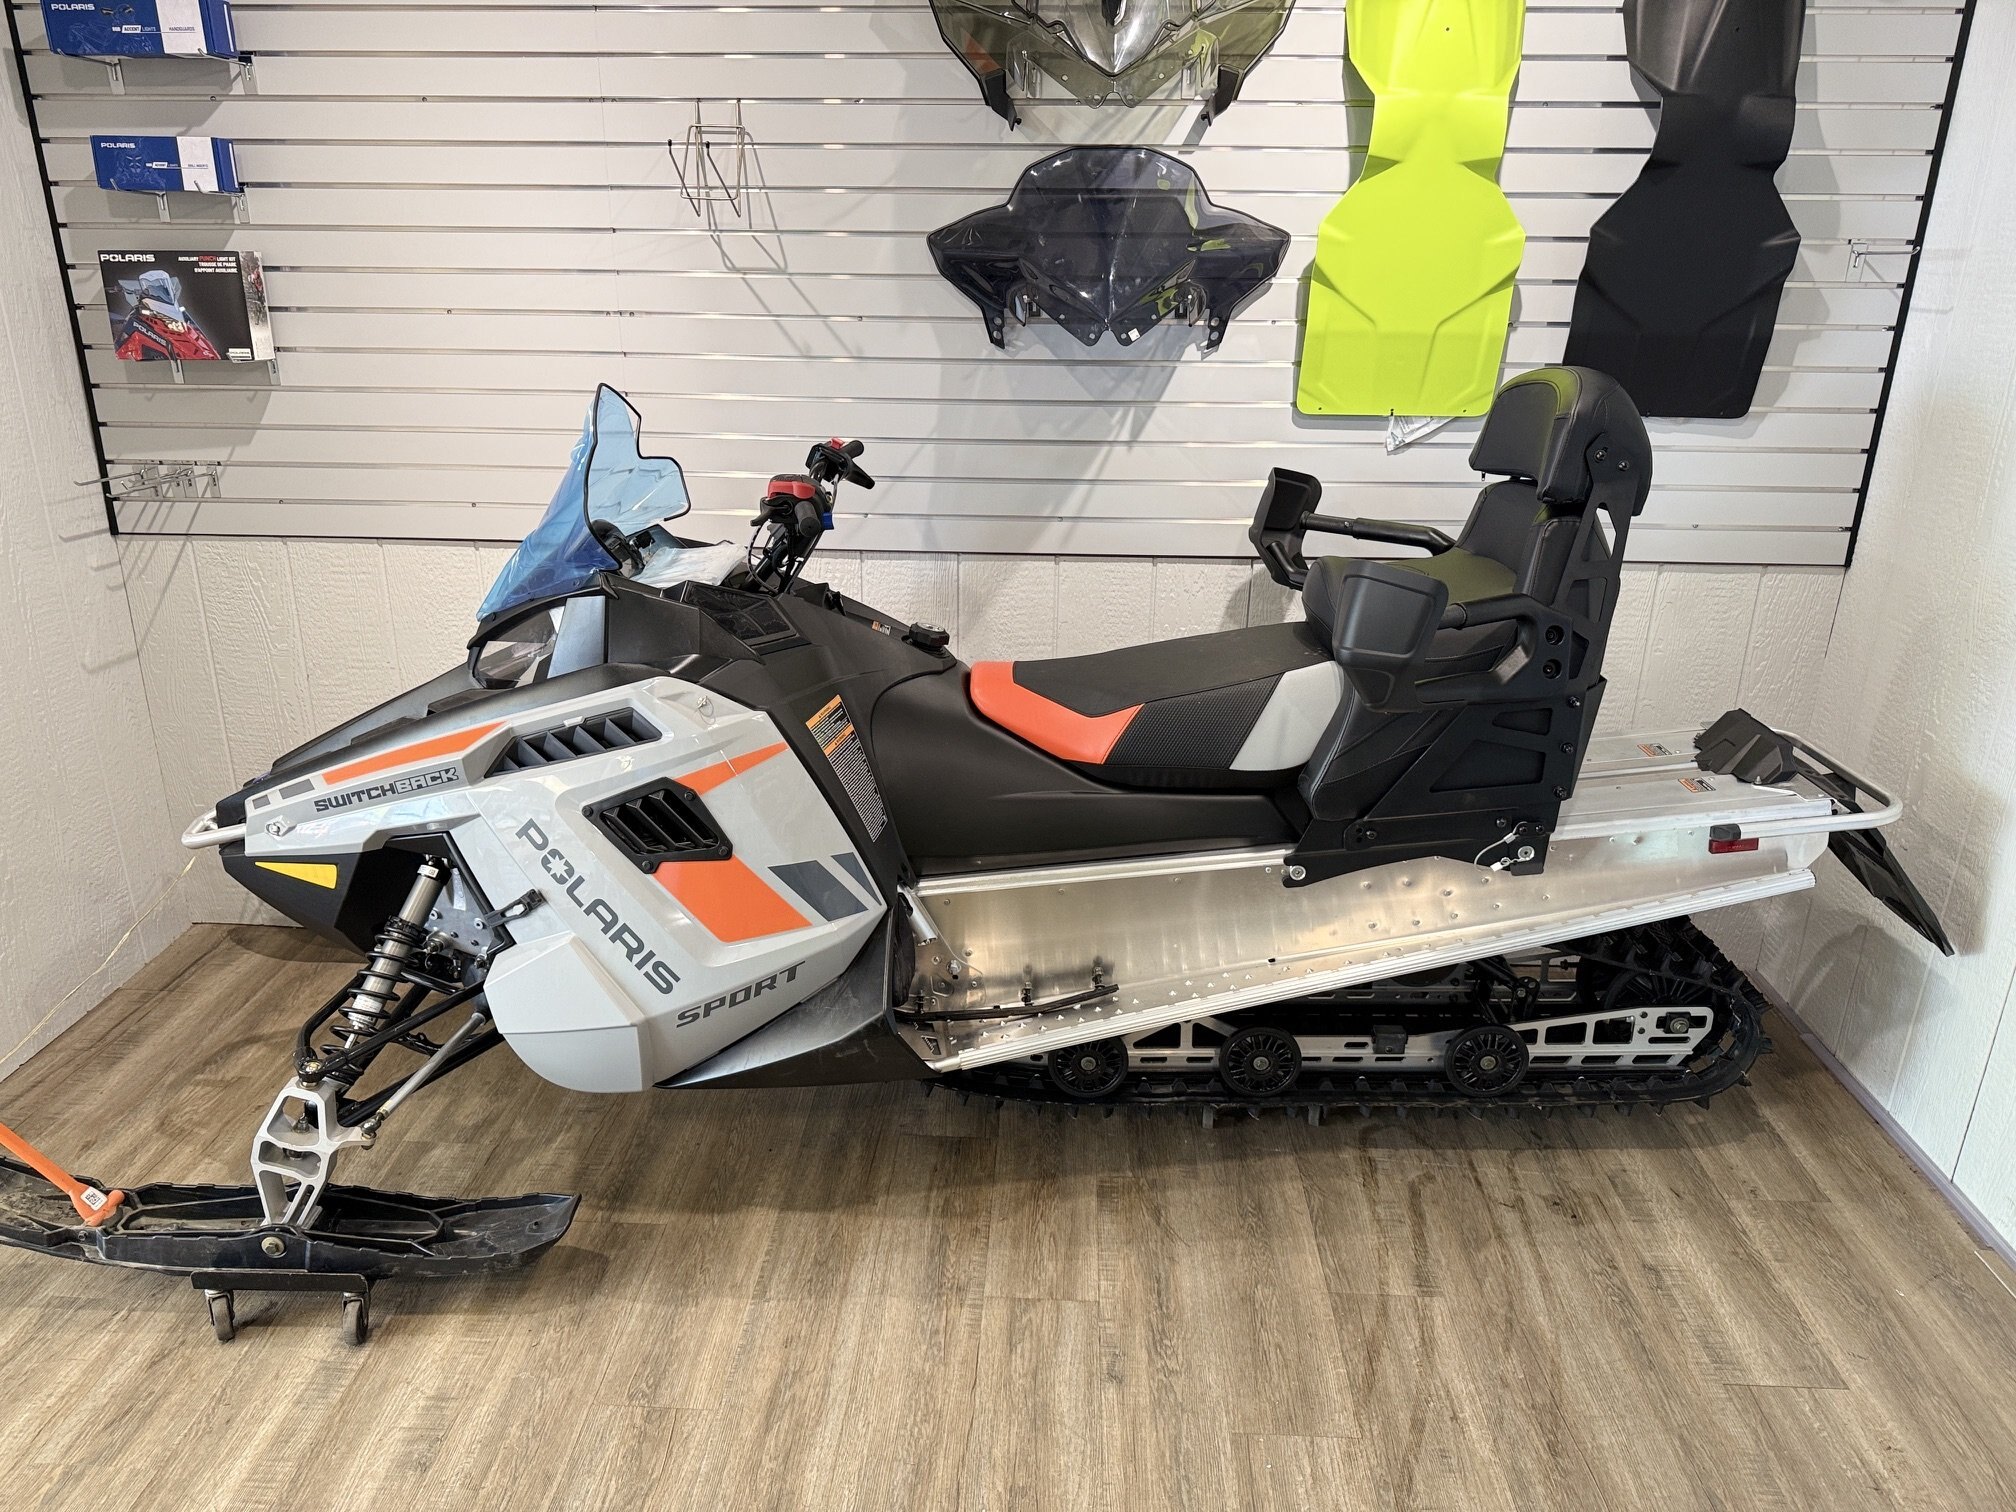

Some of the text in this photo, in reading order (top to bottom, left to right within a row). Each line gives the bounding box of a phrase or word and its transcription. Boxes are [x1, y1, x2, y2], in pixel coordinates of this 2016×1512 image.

[51, 3, 95, 11] POLARIS
[100, 254, 156, 262] POLARIS
[132, 321, 167, 346] POLARIS
[314, 766, 459, 813] SWITCHBACK
[515, 818, 681, 995] POLARIS
[676, 960, 806, 1029] SPORT
